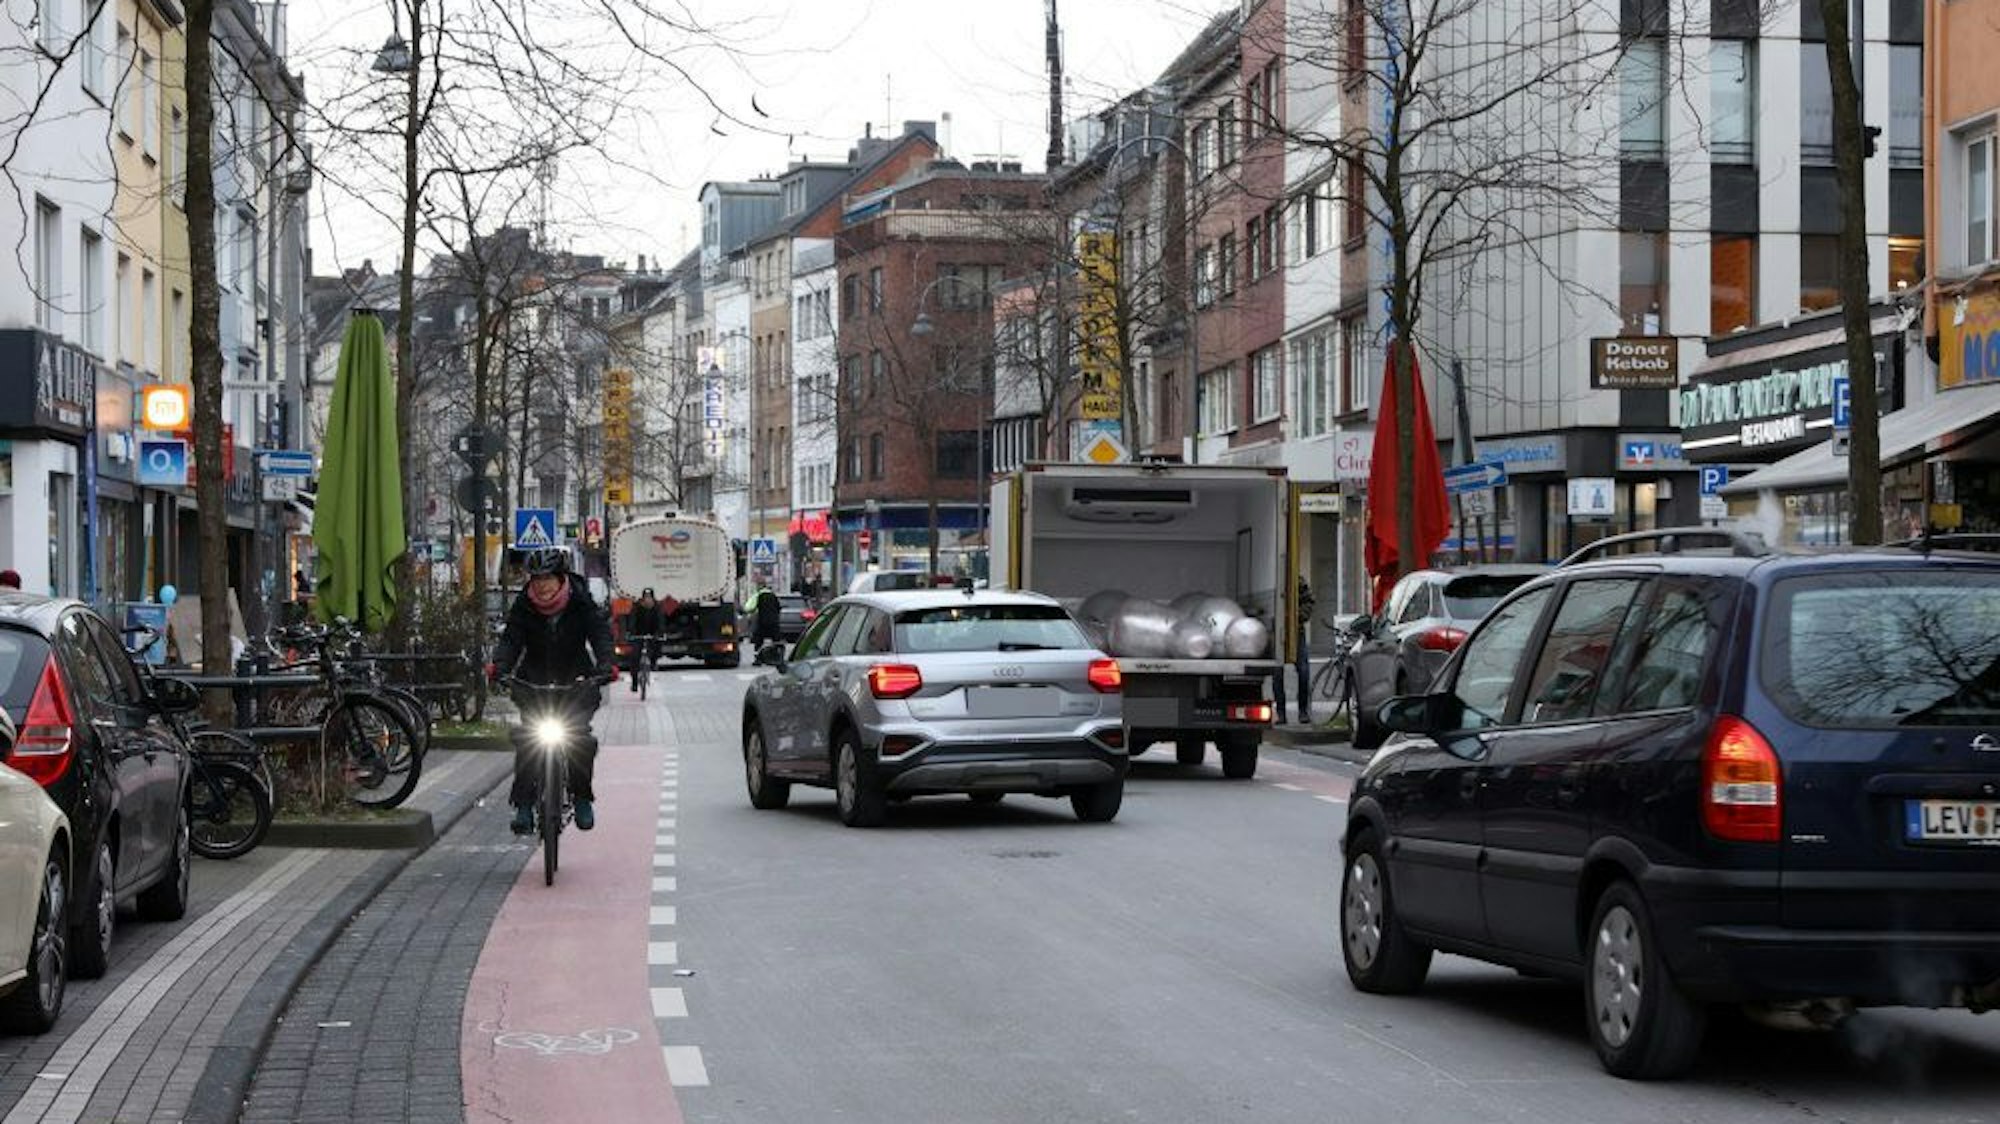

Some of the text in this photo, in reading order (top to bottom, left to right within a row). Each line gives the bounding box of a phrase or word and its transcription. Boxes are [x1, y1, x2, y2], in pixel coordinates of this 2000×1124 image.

[1606, 342, 1669, 355] Döner
[1606, 357, 1669, 370] Kebab
[608, 371, 621, 501] APOTKE
[1704, 468, 1719, 492] P
[1925, 806, 1971, 834] LEV
